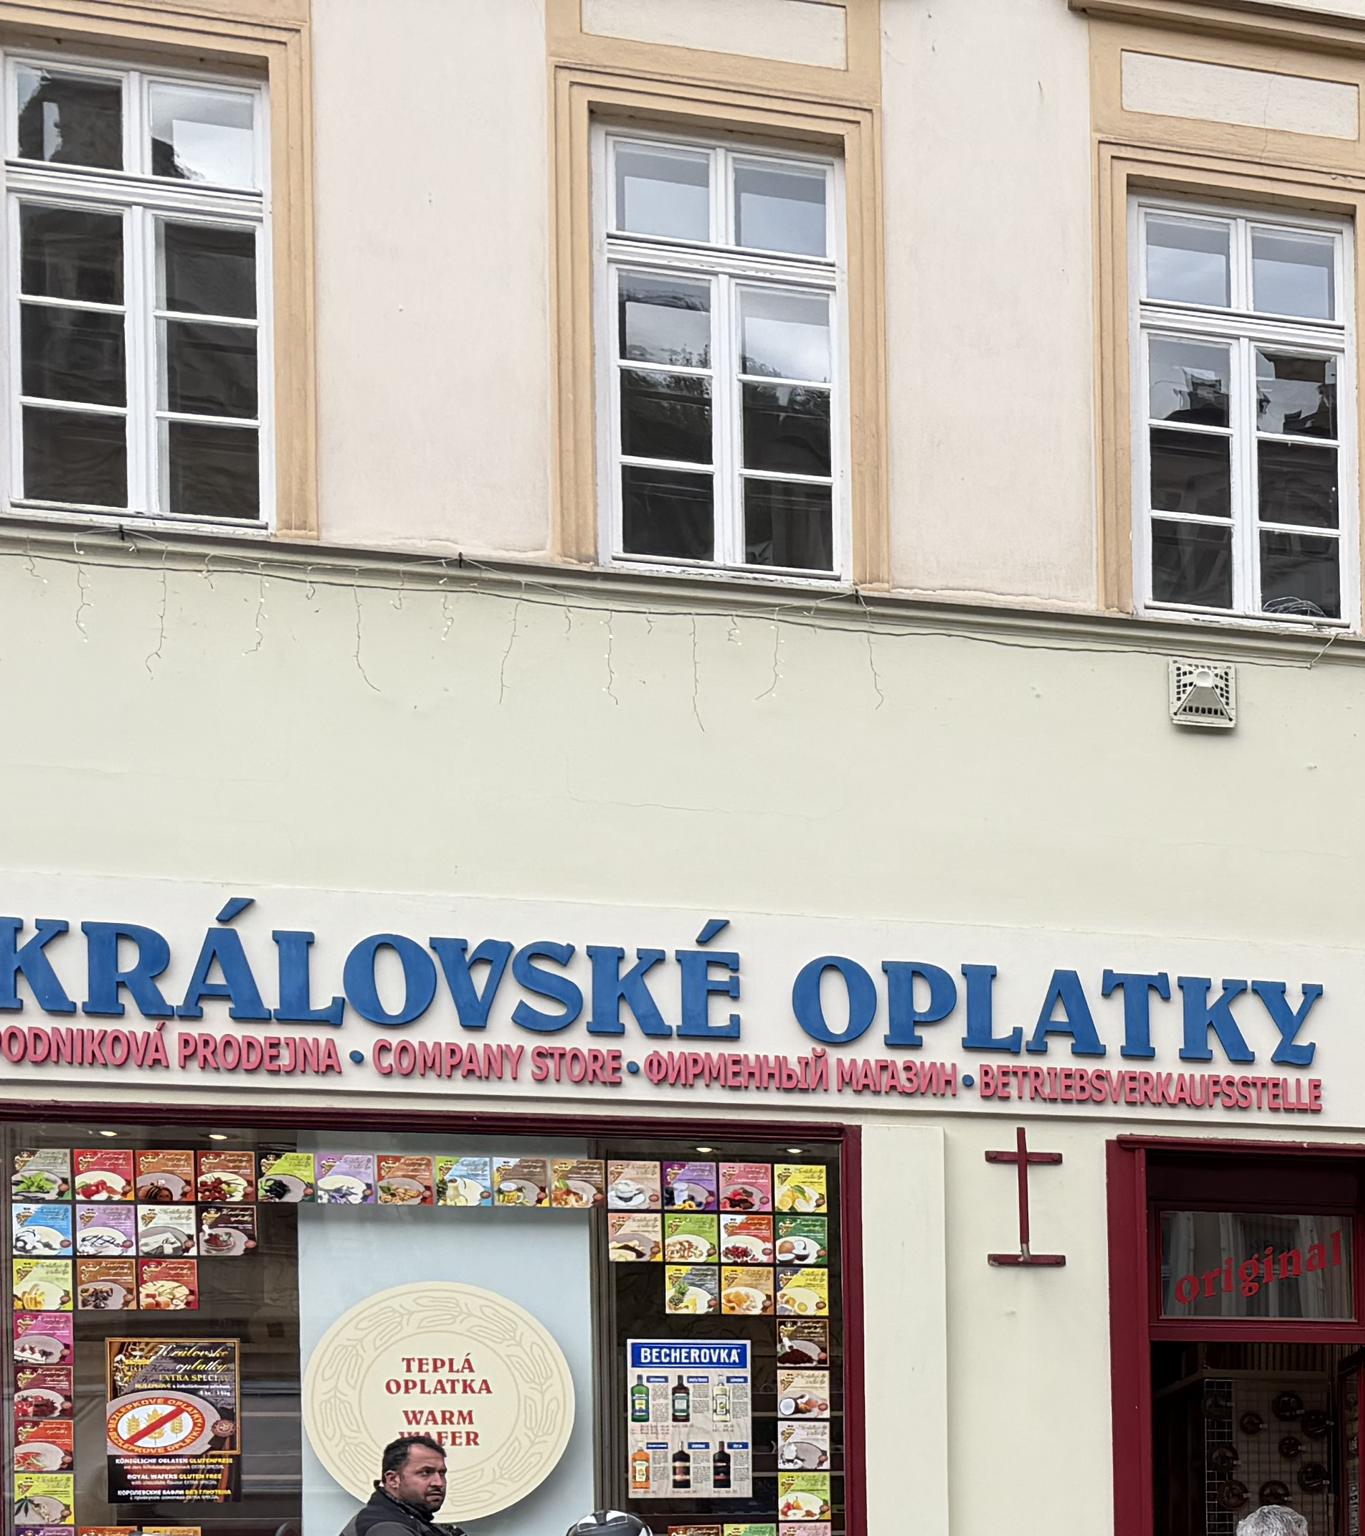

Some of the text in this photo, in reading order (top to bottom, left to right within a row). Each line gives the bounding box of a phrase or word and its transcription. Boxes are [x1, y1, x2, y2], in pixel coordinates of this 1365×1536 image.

[0, 897, 1324, 1067] KRÁLOVSKÉ OPLATKY
[178, 1031, 343, 1075] PRODEJNA
[372, 1038, 622, 1085] COMPANY STORE
[643, 1048, 957, 1097] ФИРМЕННЫЙ МАГАЗИН
[979, 1063, 1322, 1112] BETRIEBSVERKAUFSSTELLE
[1174, 1229, 1343, 1305] original
[402, 1353, 475, 1374] TEPLÁ
[640, 1347, 740, 1363] BECHEROVKA
[385, 1378, 493, 1395] OPLATKA
[402, 1409, 475, 1426] WARM
